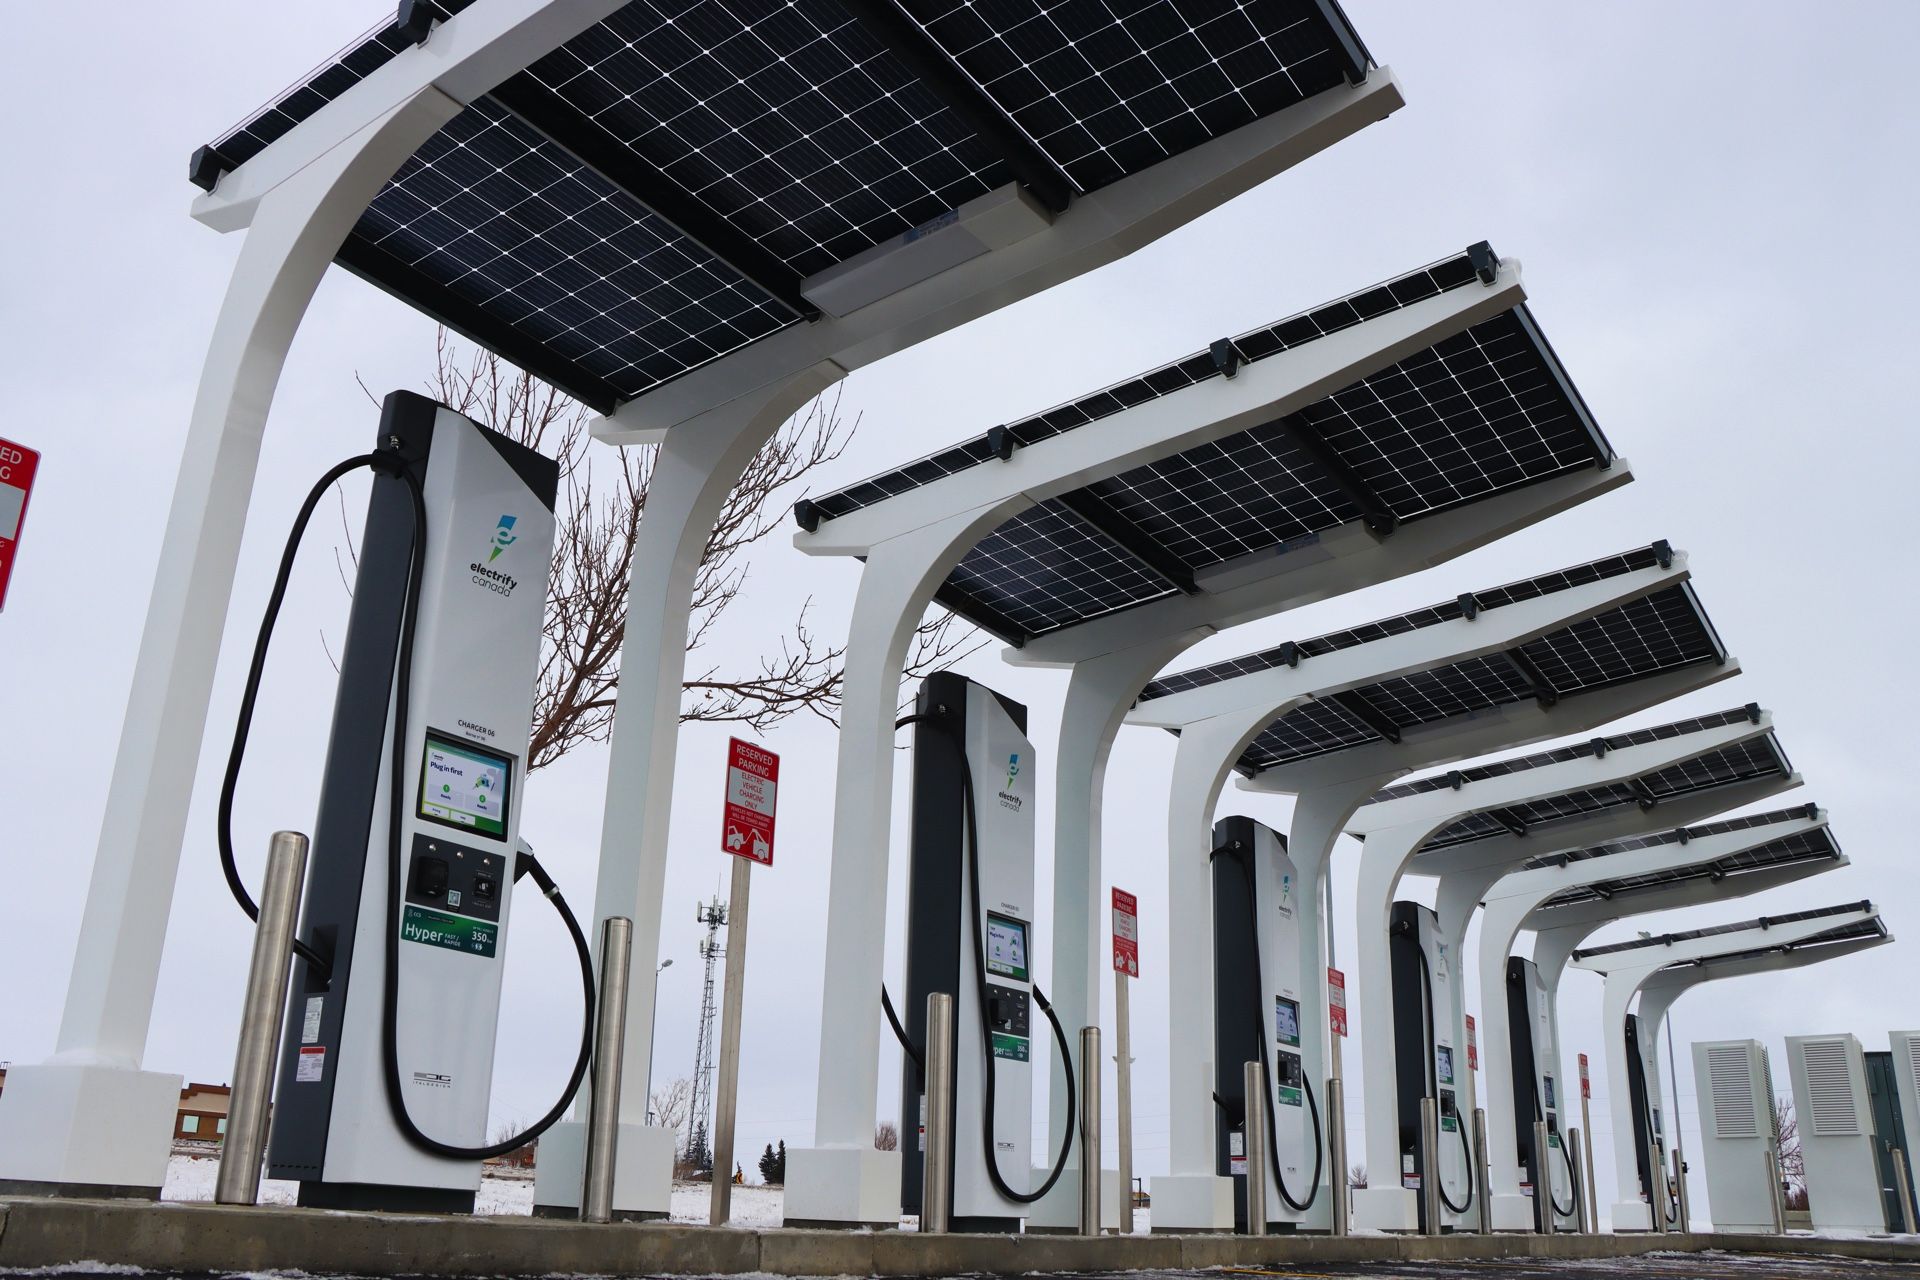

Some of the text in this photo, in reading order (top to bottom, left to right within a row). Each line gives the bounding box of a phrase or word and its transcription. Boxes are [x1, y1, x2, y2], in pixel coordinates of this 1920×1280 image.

[0, 446, 22, 465] ED
[470, 562, 517, 590] electrify
[472, 575, 511, 597] canada
[457, 719, 495, 737] CHARGER 06
[736, 744, 773, 766] RESERVED
[430, 761, 463, 776] Plug in first
[738, 757, 769, 777] PARKING
[741, 772, 764, 785] ELECTRIC
[739, 789, 764, 803] CHARGING
[742, 781, 762, 794] VEHICLE
[744, 800, 758, 810] ONLY
[999, 791, 1022, 807] electrify
[405, 922, 444, 942] Hyper
[472, 931, 487, 942] 350
